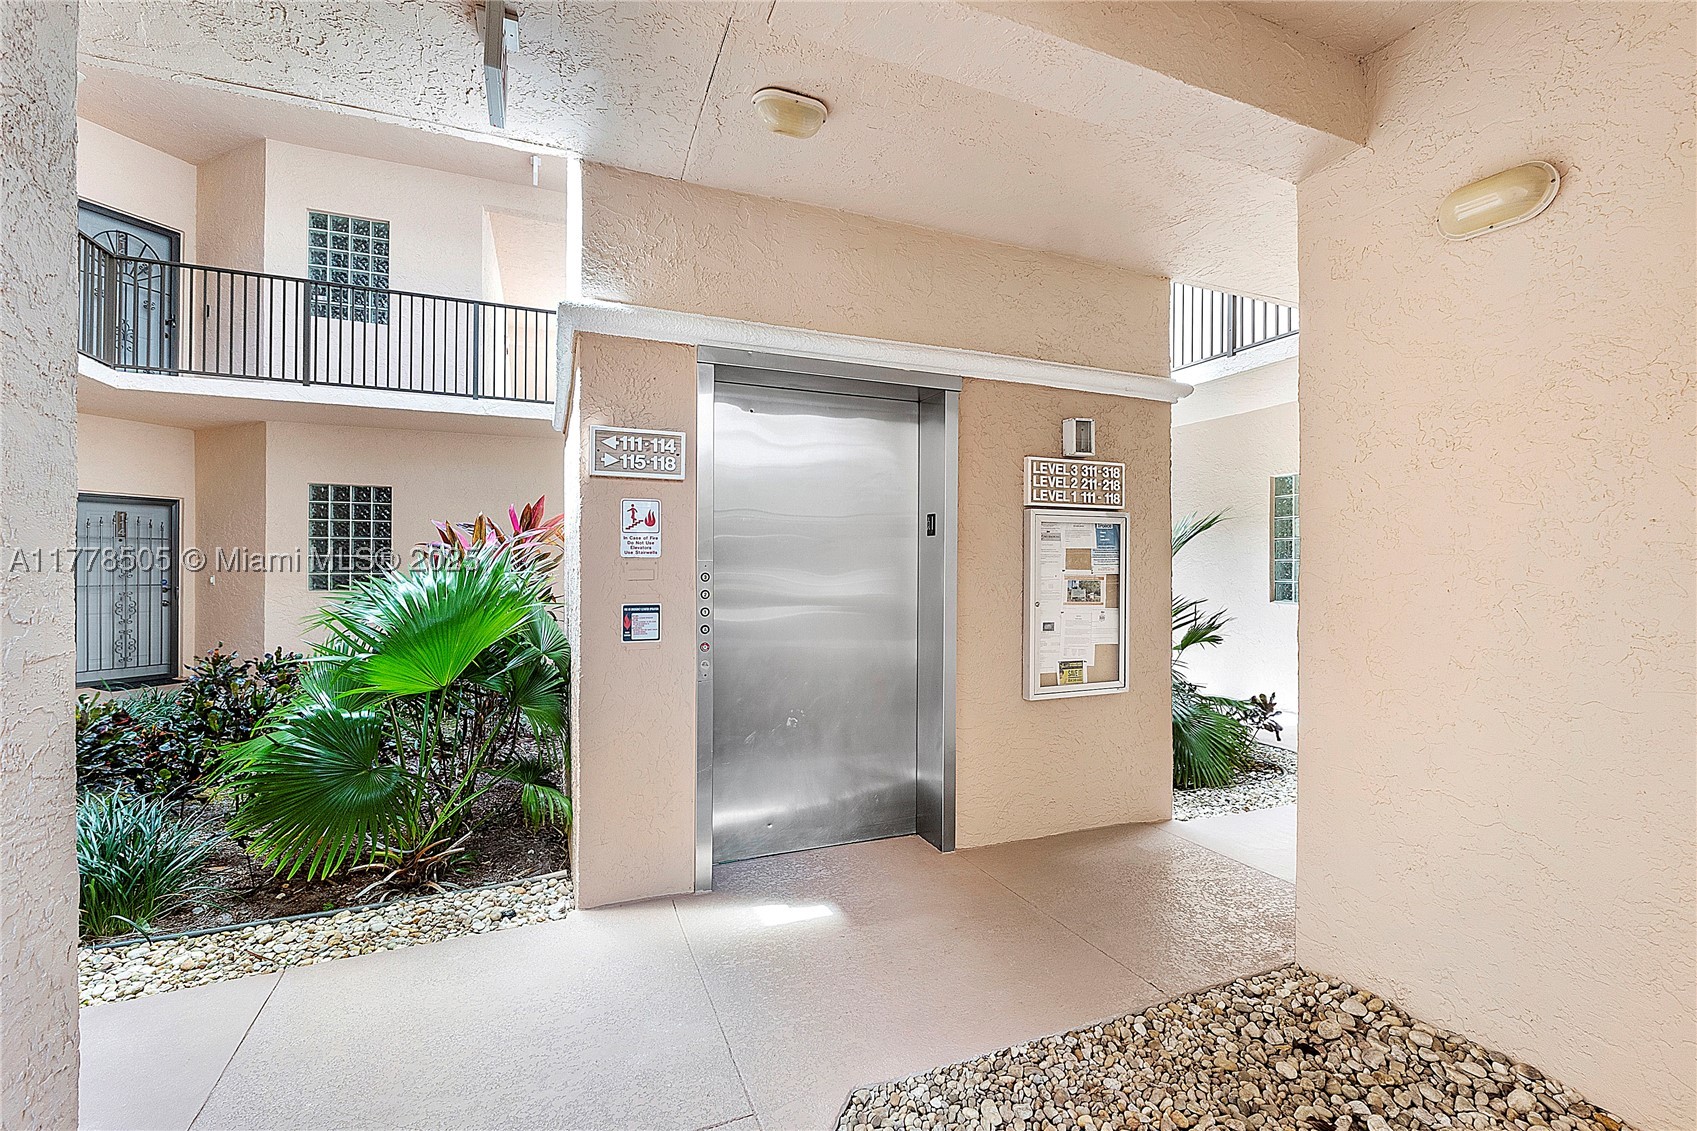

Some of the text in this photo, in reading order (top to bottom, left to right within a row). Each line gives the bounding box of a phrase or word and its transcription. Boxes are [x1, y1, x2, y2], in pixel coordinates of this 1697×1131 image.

[1032, 462, 1070, 475] LEVEL
[1070, 465, 1078, 476] 3
[1032, 475, 1070, 488] LEVEL
[1070, 477, 1078, 489] 2
[1032, 489, 1070, 501] LEVEL
[1070, 491, 1077, 502] 1
[118, 512, 126, 536] 114
